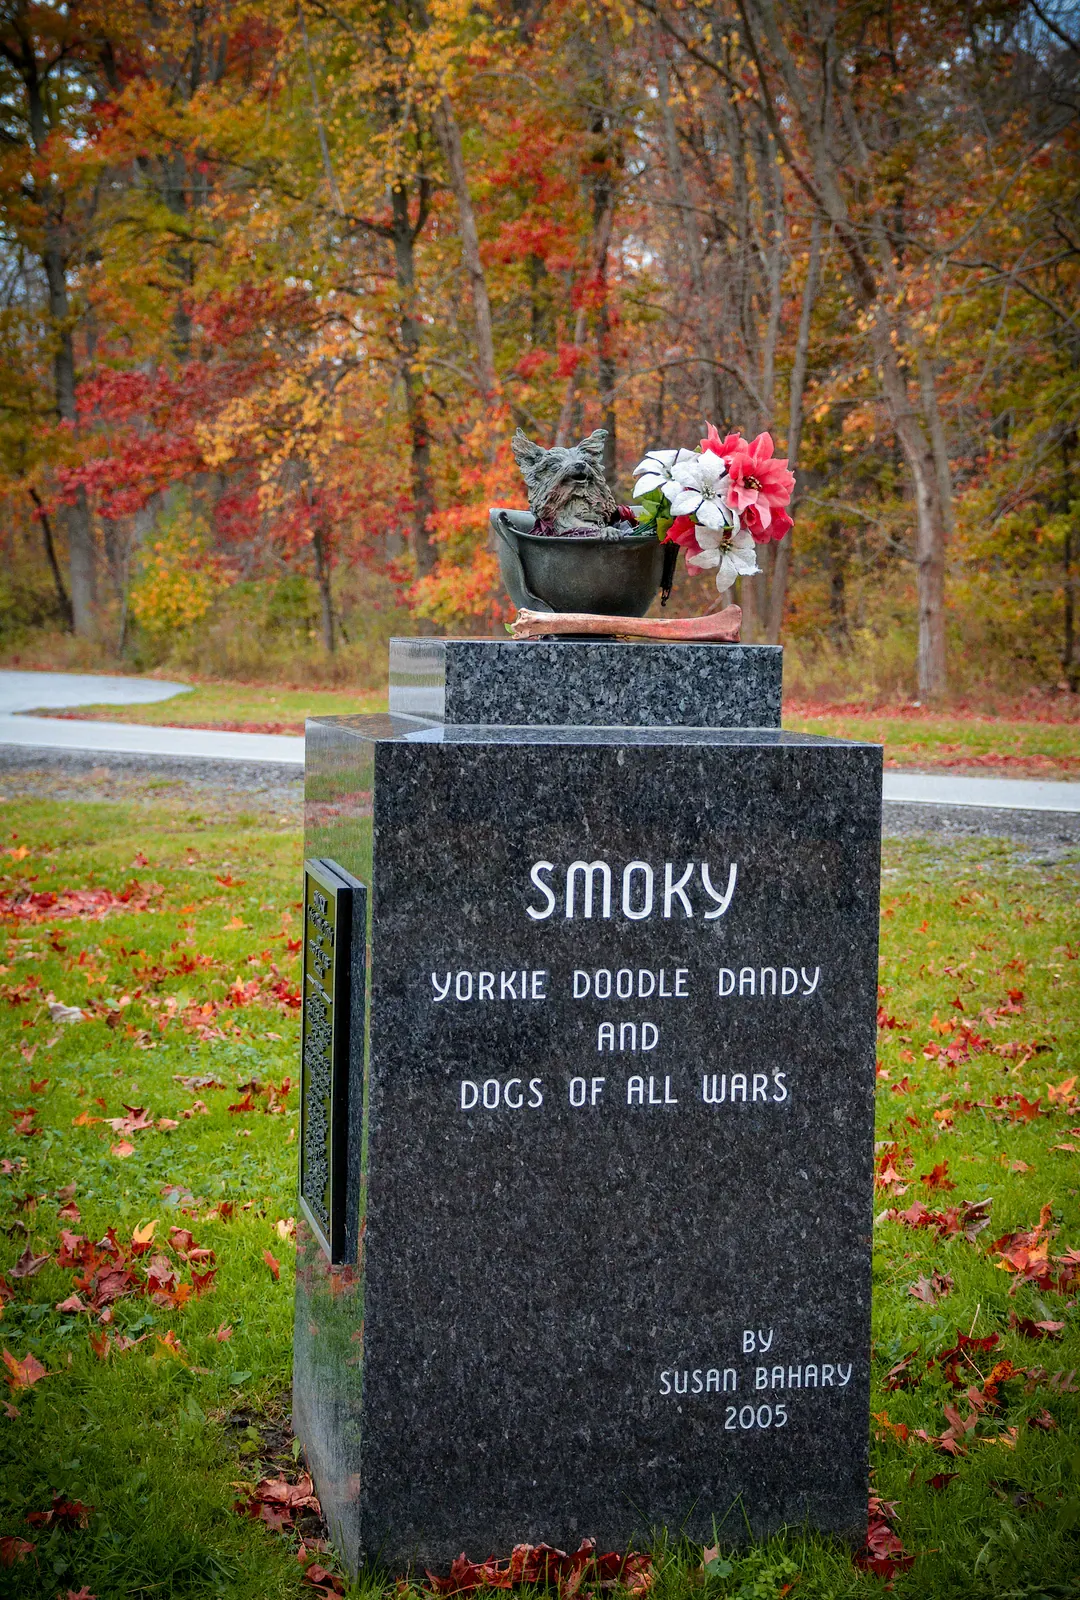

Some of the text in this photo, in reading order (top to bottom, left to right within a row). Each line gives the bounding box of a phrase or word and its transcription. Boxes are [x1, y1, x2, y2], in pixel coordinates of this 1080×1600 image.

[525, 860, 738, 921] SMOKY
[431, 966, 820, 1002] YORKIE DOODLE DANDY
[597, 1021, 659, 1051] AND
[460, 1072, 788, 1110] DOGS OF ALL WARS
[742, 1329, 774, 1353] BY
[659, 1363, 852, 1395] SUSAN BAHARY
[724, 1404, 788, 1430] 2005
